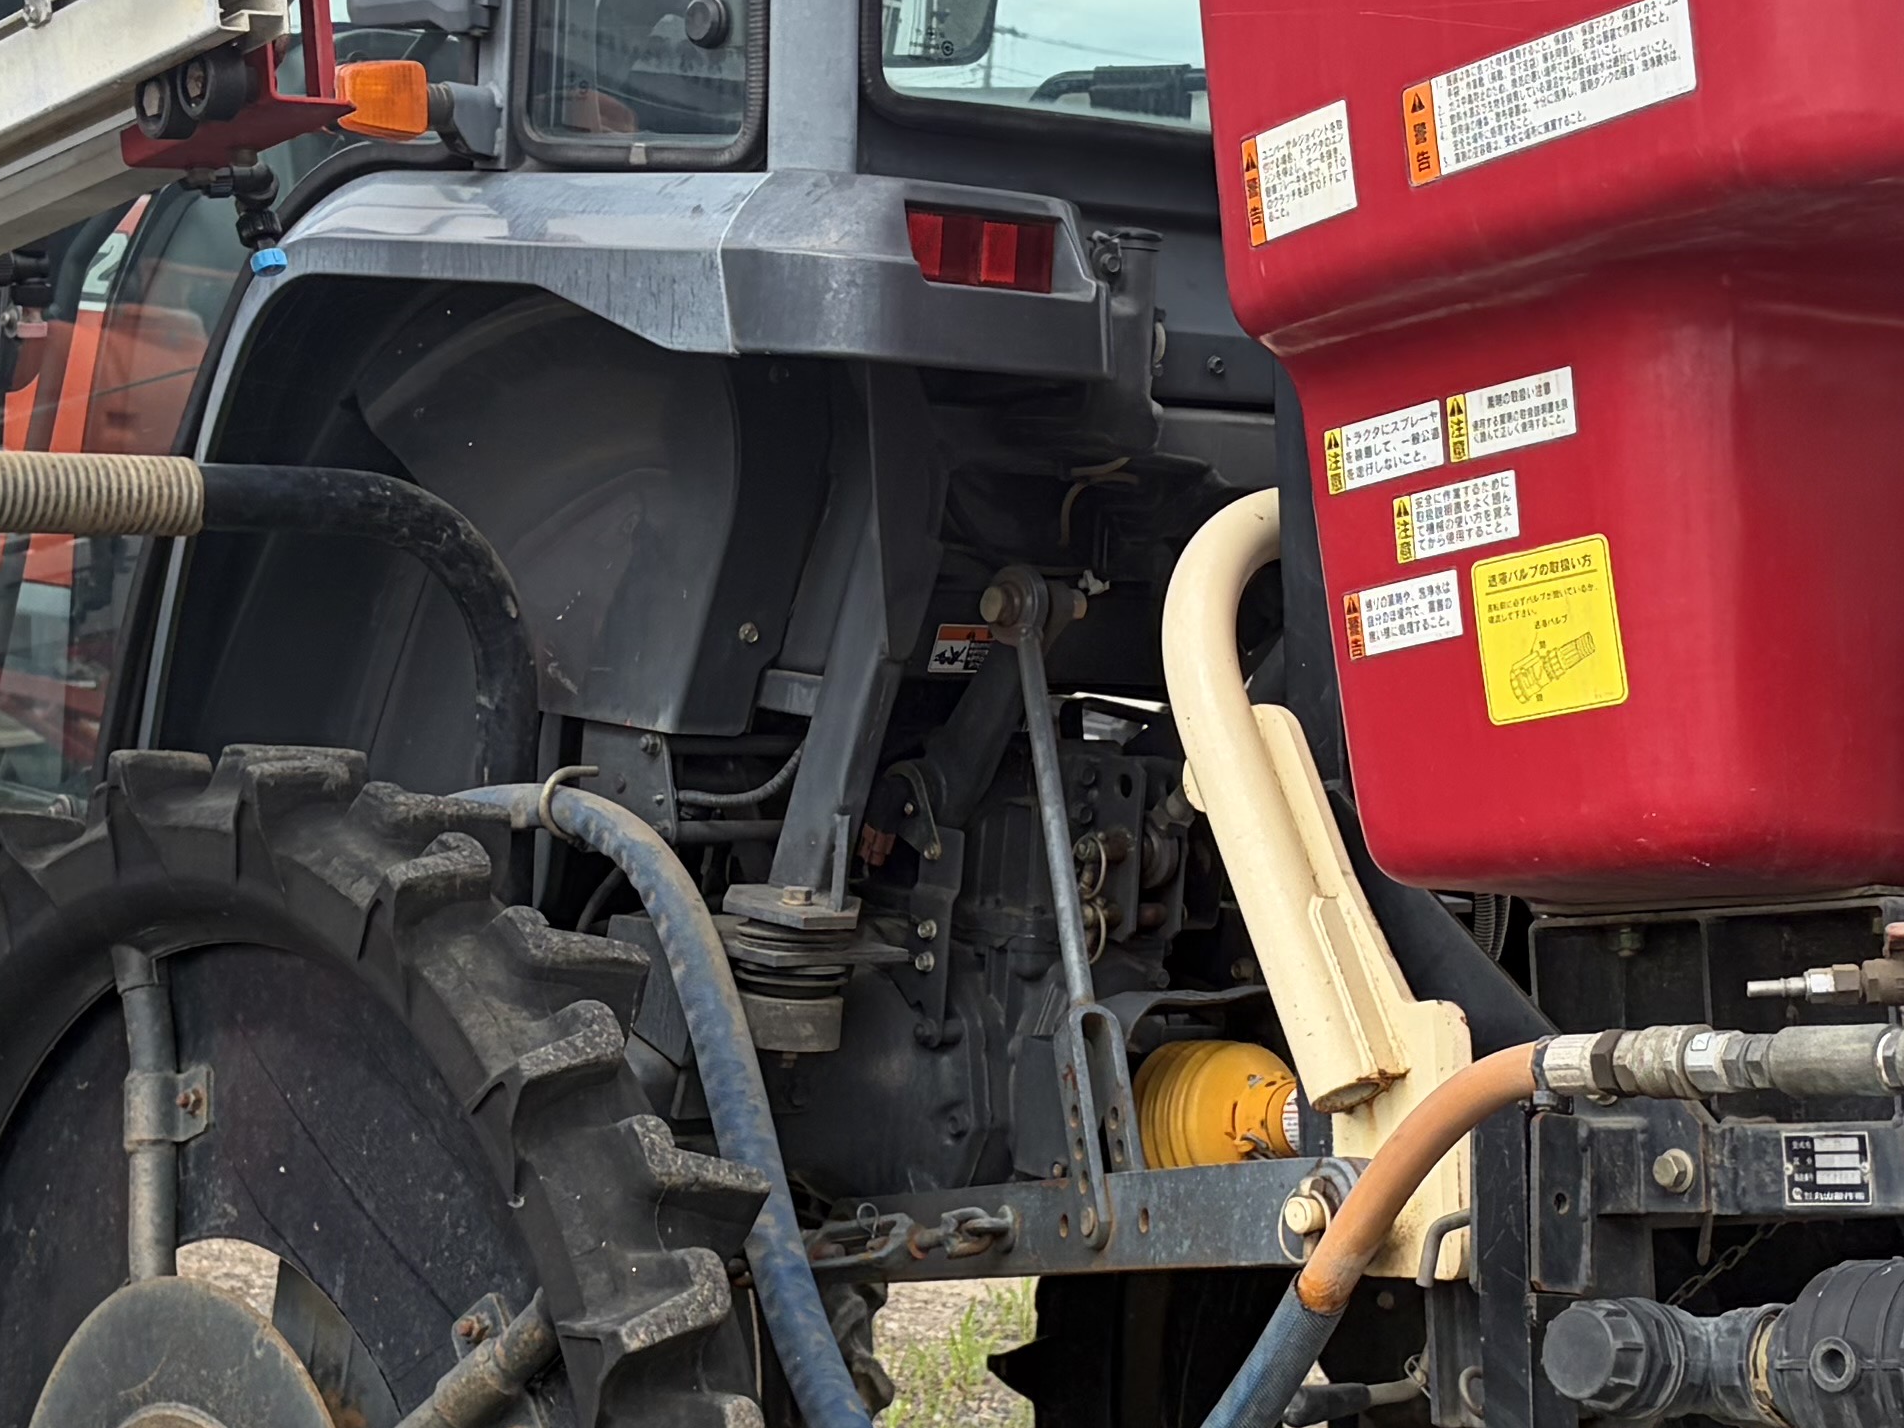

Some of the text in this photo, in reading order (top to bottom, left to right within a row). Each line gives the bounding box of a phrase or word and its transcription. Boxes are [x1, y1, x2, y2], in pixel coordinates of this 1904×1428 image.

[1345, 409, 1438, 447] トラクタにスプレーヤ
